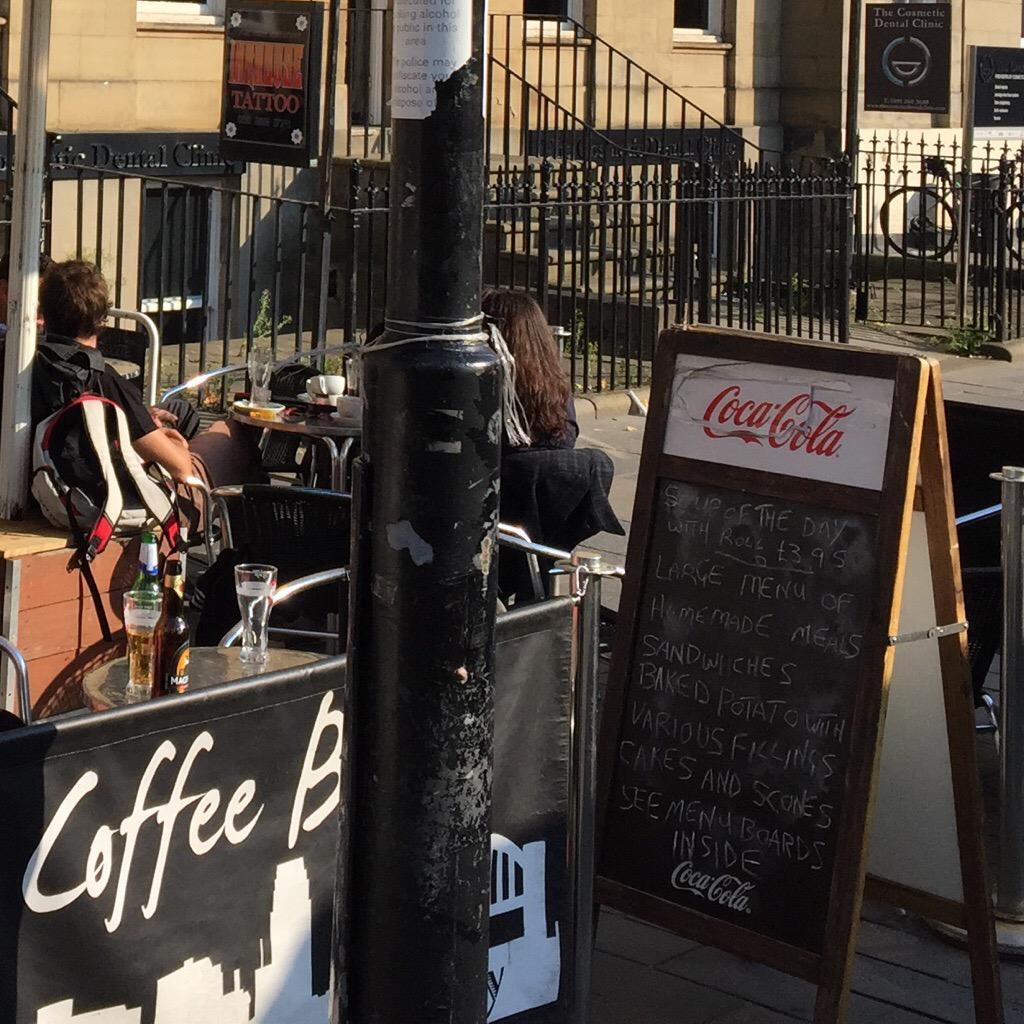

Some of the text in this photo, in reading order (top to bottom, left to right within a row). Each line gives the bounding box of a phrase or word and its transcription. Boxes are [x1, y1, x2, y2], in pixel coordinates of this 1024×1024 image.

[419, 8, 461, 19] alcohol
[423, 22, 433, 33] in
[437, 22, 458, 33] this
[873, 7, 945, 18] The Cosmetic
[874, 18, 944, 29] Dental Clinic
[405, 37, 427, 46] area
[433, 58, 456, 69] may
[231, 90, 301, 115] TATTOO
[90, 142, 168, 170] Dental
[703, 385, 857, 458] Coca-Cola
[664, 486, 722, 511] SUP
[753, 504, 793, 528] THE
[802, 516, 849, 546] DAY
[667, 520, 709, 546] WITH
[655, 554, 855, 613] LARGE MENU OF
[642, 634, 797, 685] SANDWICHES
[790, 625, 864, 660] MEALS
[170, 674, 189, 686] MAG
[639, 661, 846, 743] BAKED POTATO WITH
[631, 700, 837, 778] VARIOUS FILLINGS
[619, 739, 833, 829] CAKES AND SCONES
[21, 730, 266, 934] Coffee
[619, 785, 826, 871] SEE MENU BOARDS
[672, 830, 761, 876] INSIDE
[671, 860, 757, 914] Coca-Cola
